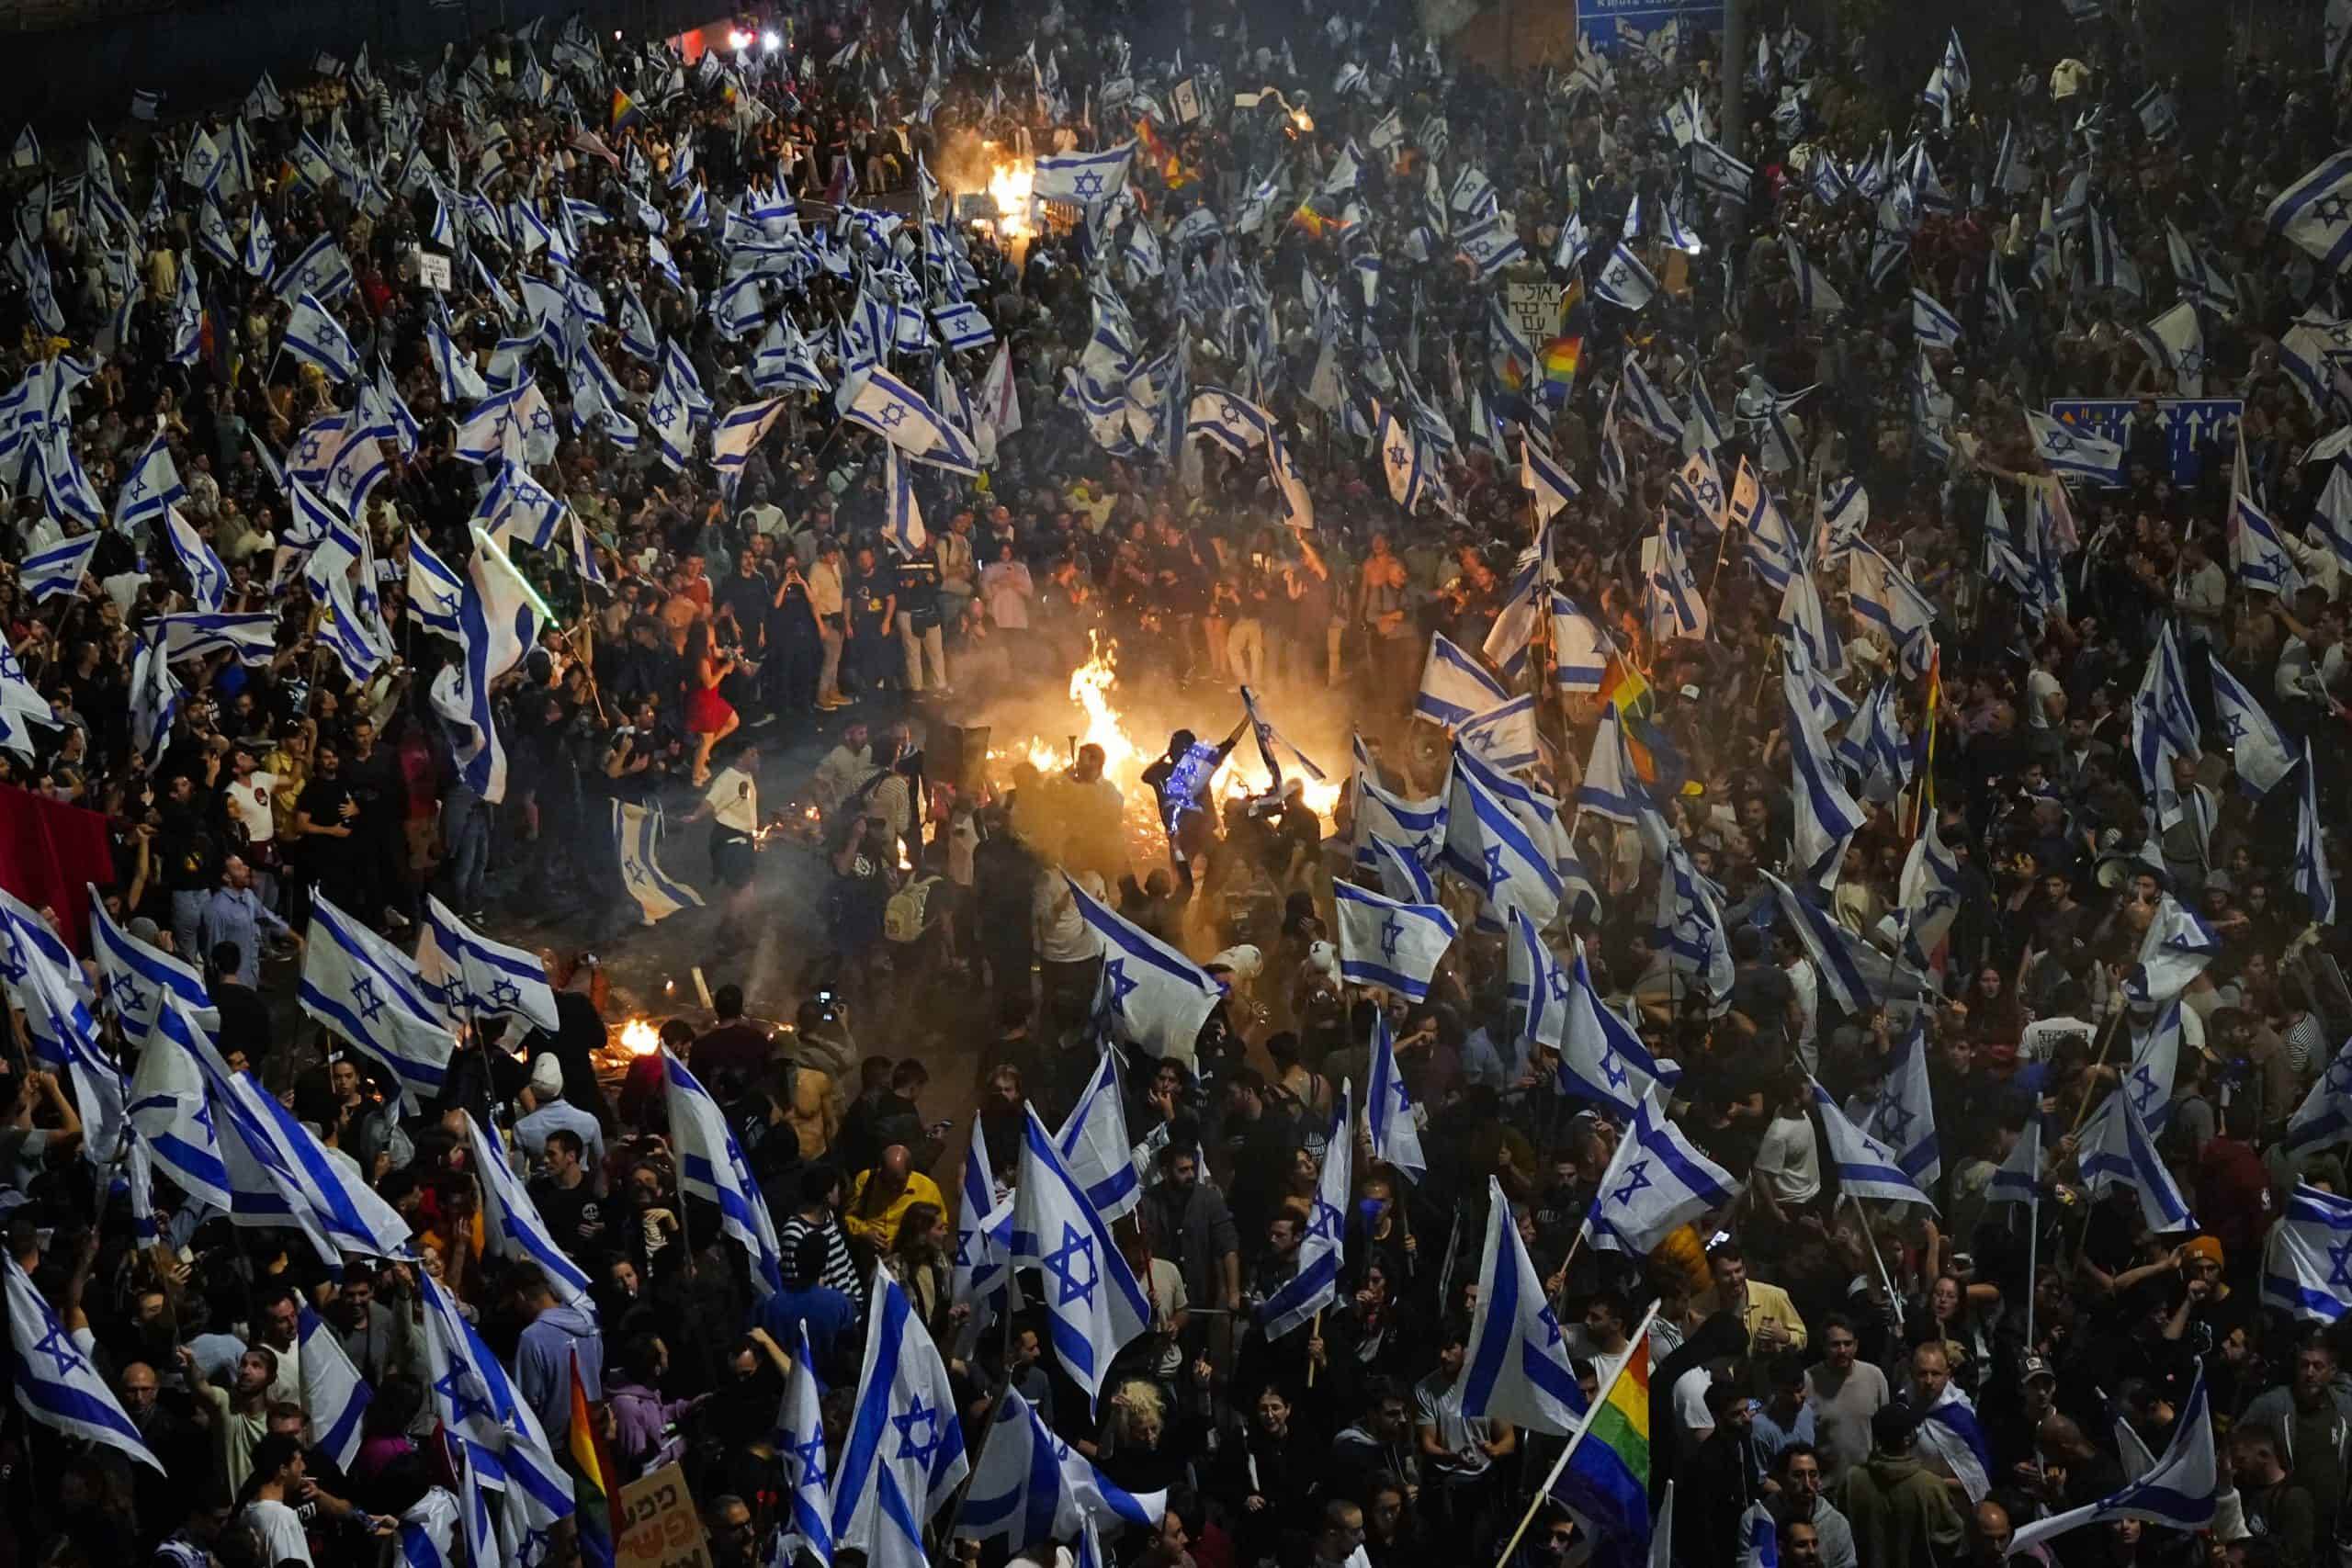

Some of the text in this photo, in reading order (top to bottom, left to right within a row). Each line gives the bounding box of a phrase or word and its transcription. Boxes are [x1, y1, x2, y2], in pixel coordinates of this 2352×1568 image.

[1519, 286, 1553, 301] אולי
[1510, 301, 1559, 316] די כבר
[1521, 315, 1545, 331] עם
